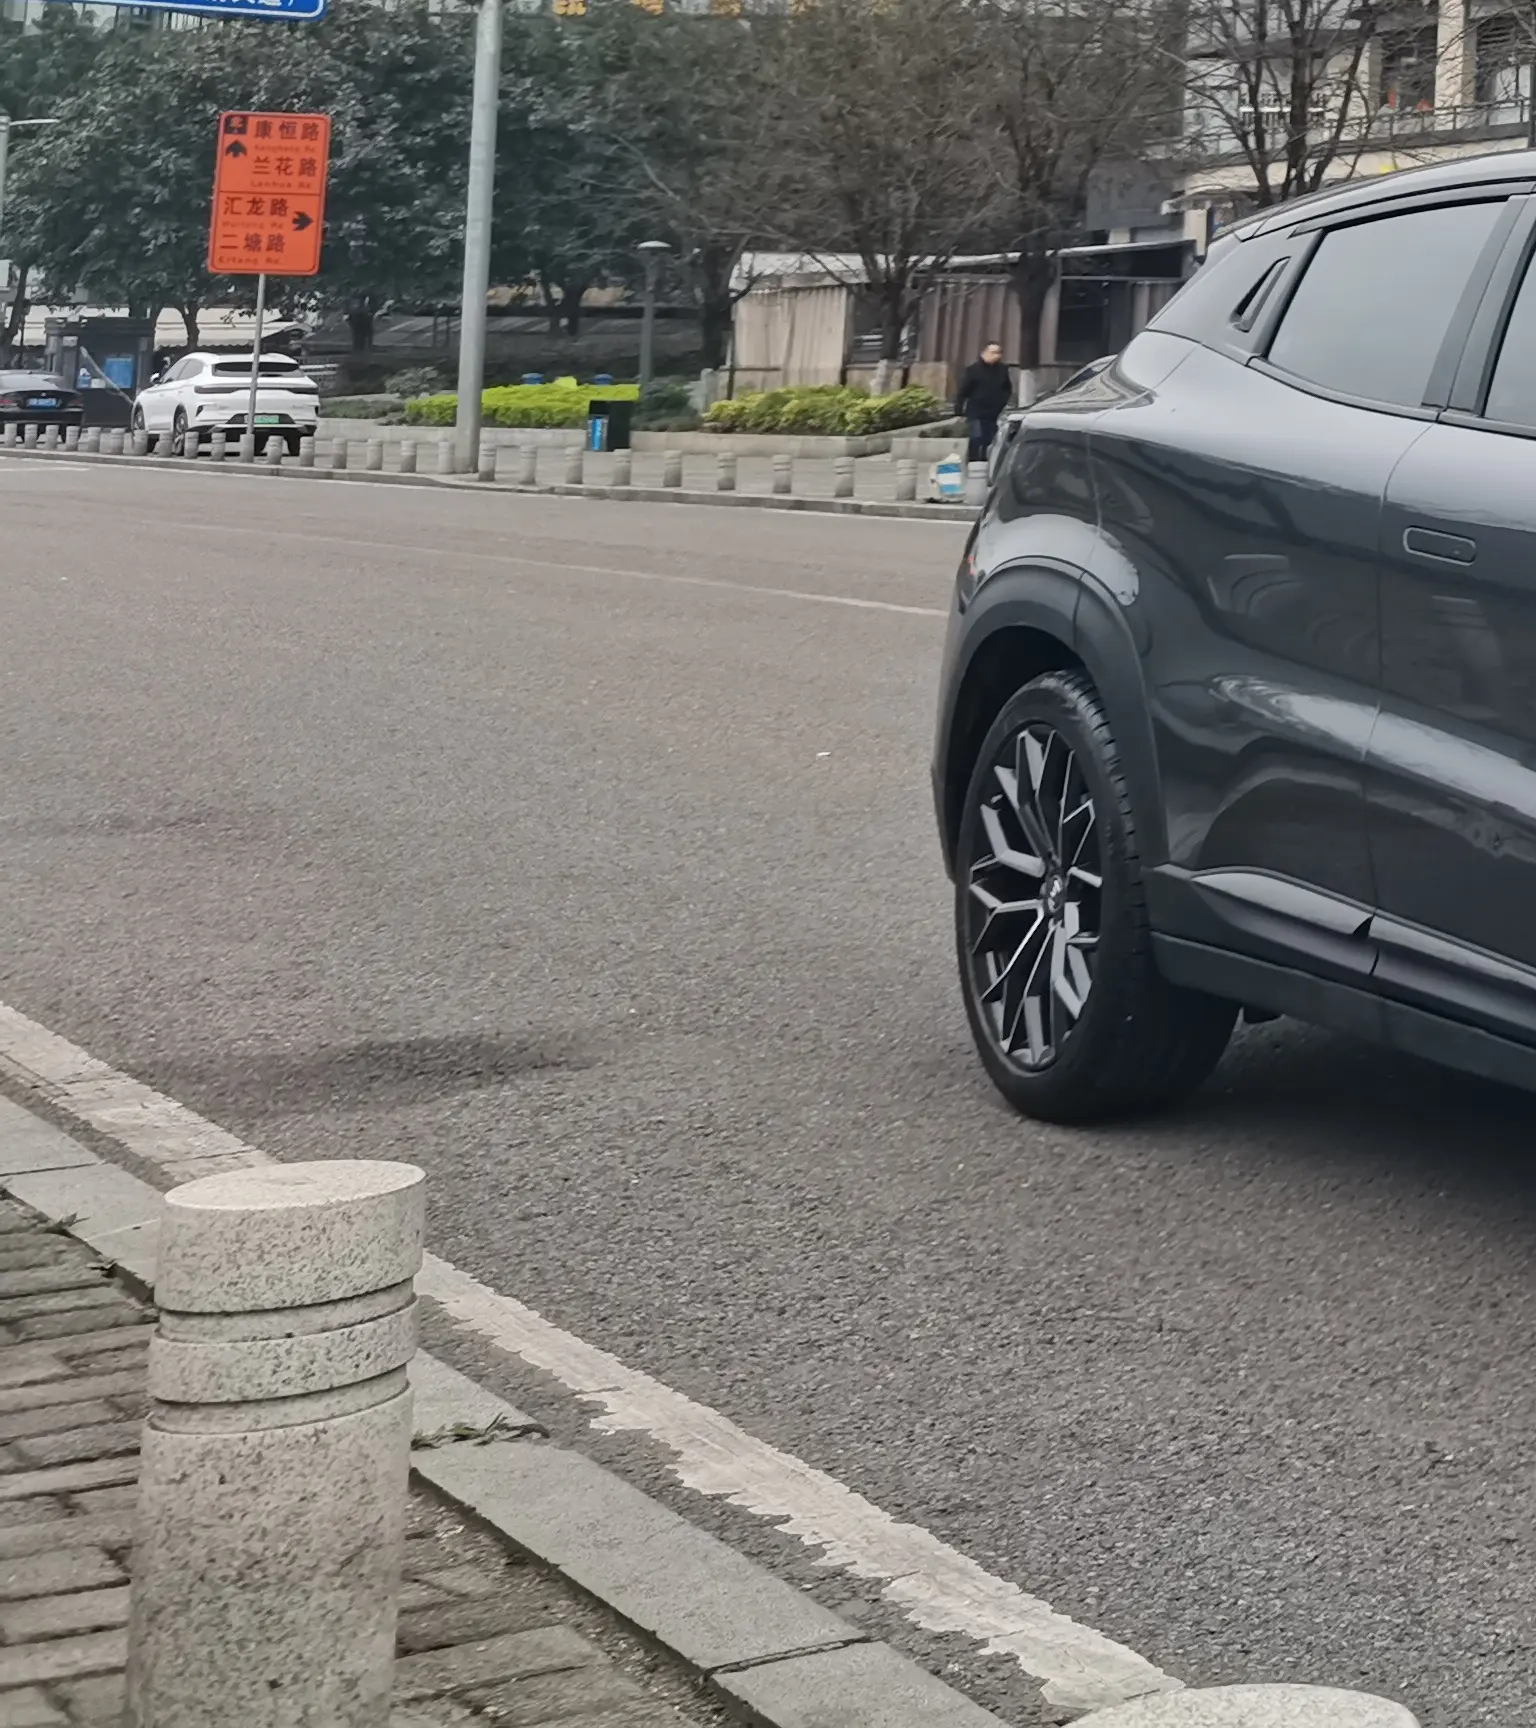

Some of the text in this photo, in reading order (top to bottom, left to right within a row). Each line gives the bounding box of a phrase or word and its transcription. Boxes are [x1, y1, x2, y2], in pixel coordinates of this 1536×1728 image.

[251, 156, 318, 177] 兰花路
[223, 196, 290, 217] 汇龙路
